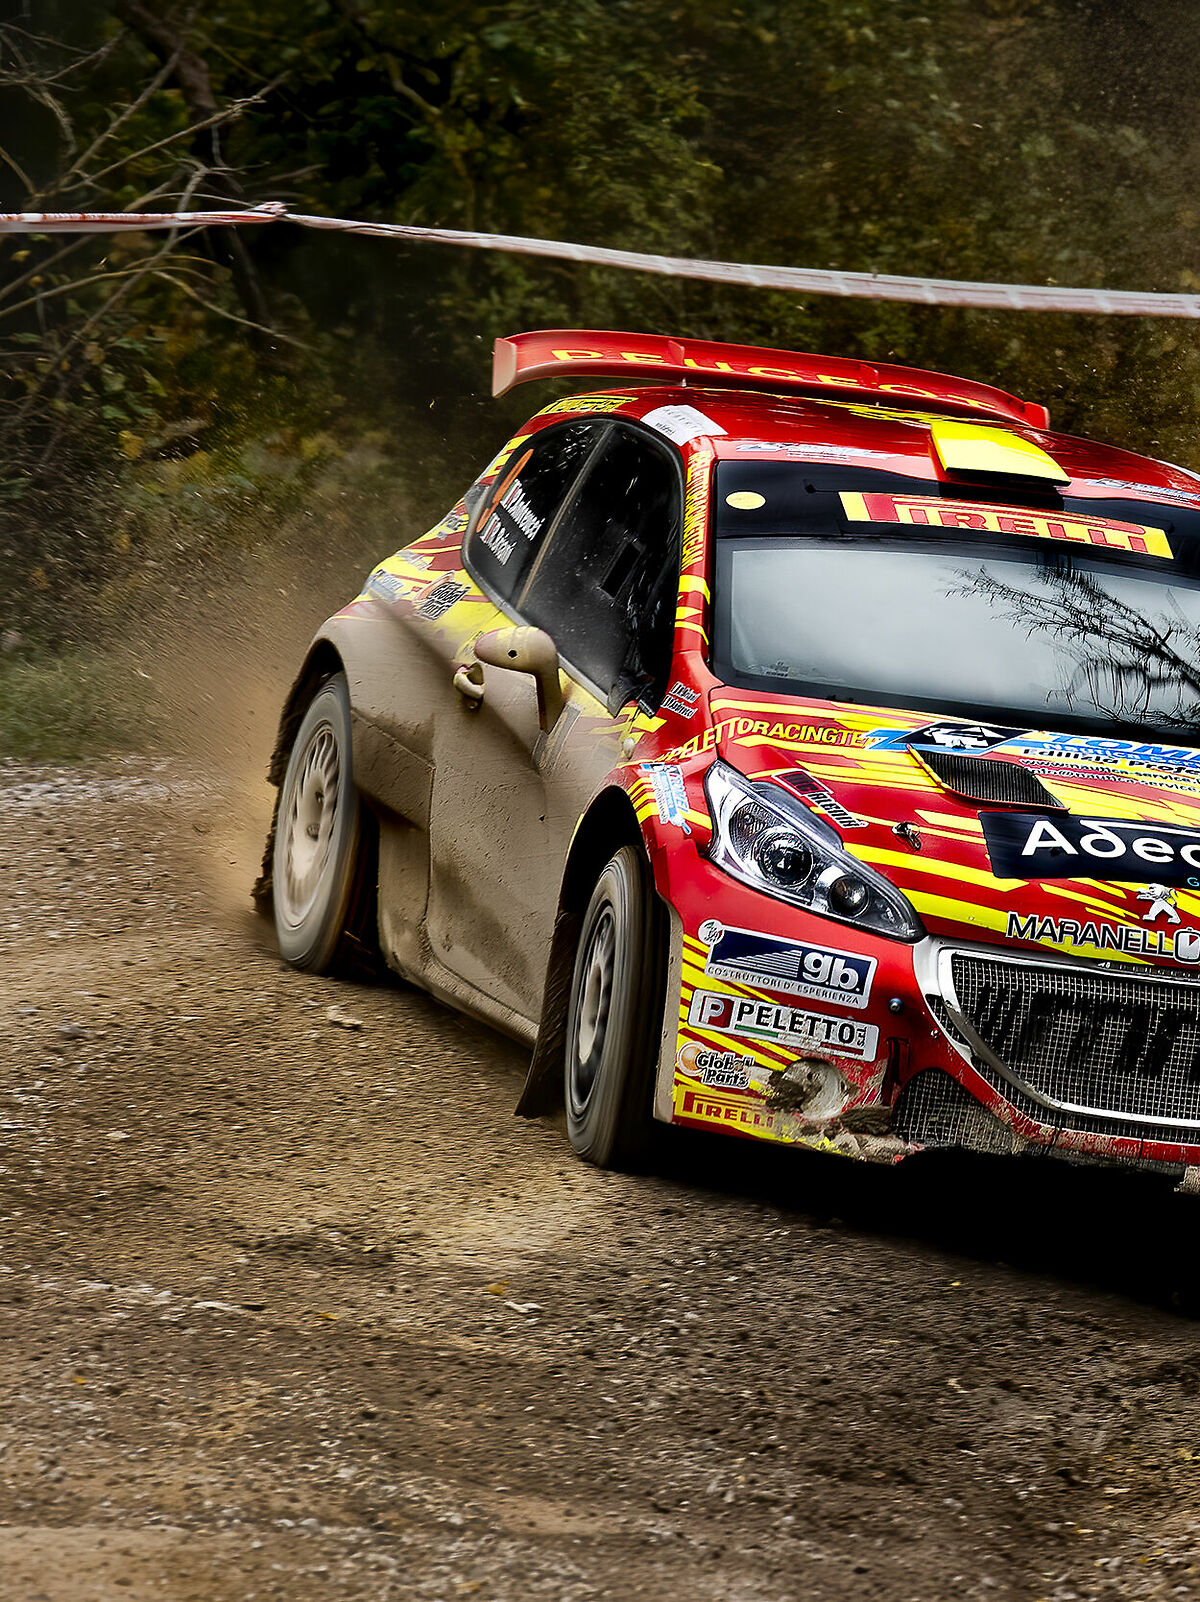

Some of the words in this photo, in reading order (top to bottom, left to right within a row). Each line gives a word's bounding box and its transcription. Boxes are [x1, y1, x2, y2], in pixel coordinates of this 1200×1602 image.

[862, 494, 1148, 553] PIRELLI
[797, 984, 860, 1005] ESPERIENZA
[737, 1001, 855, 1044] PELETTO
